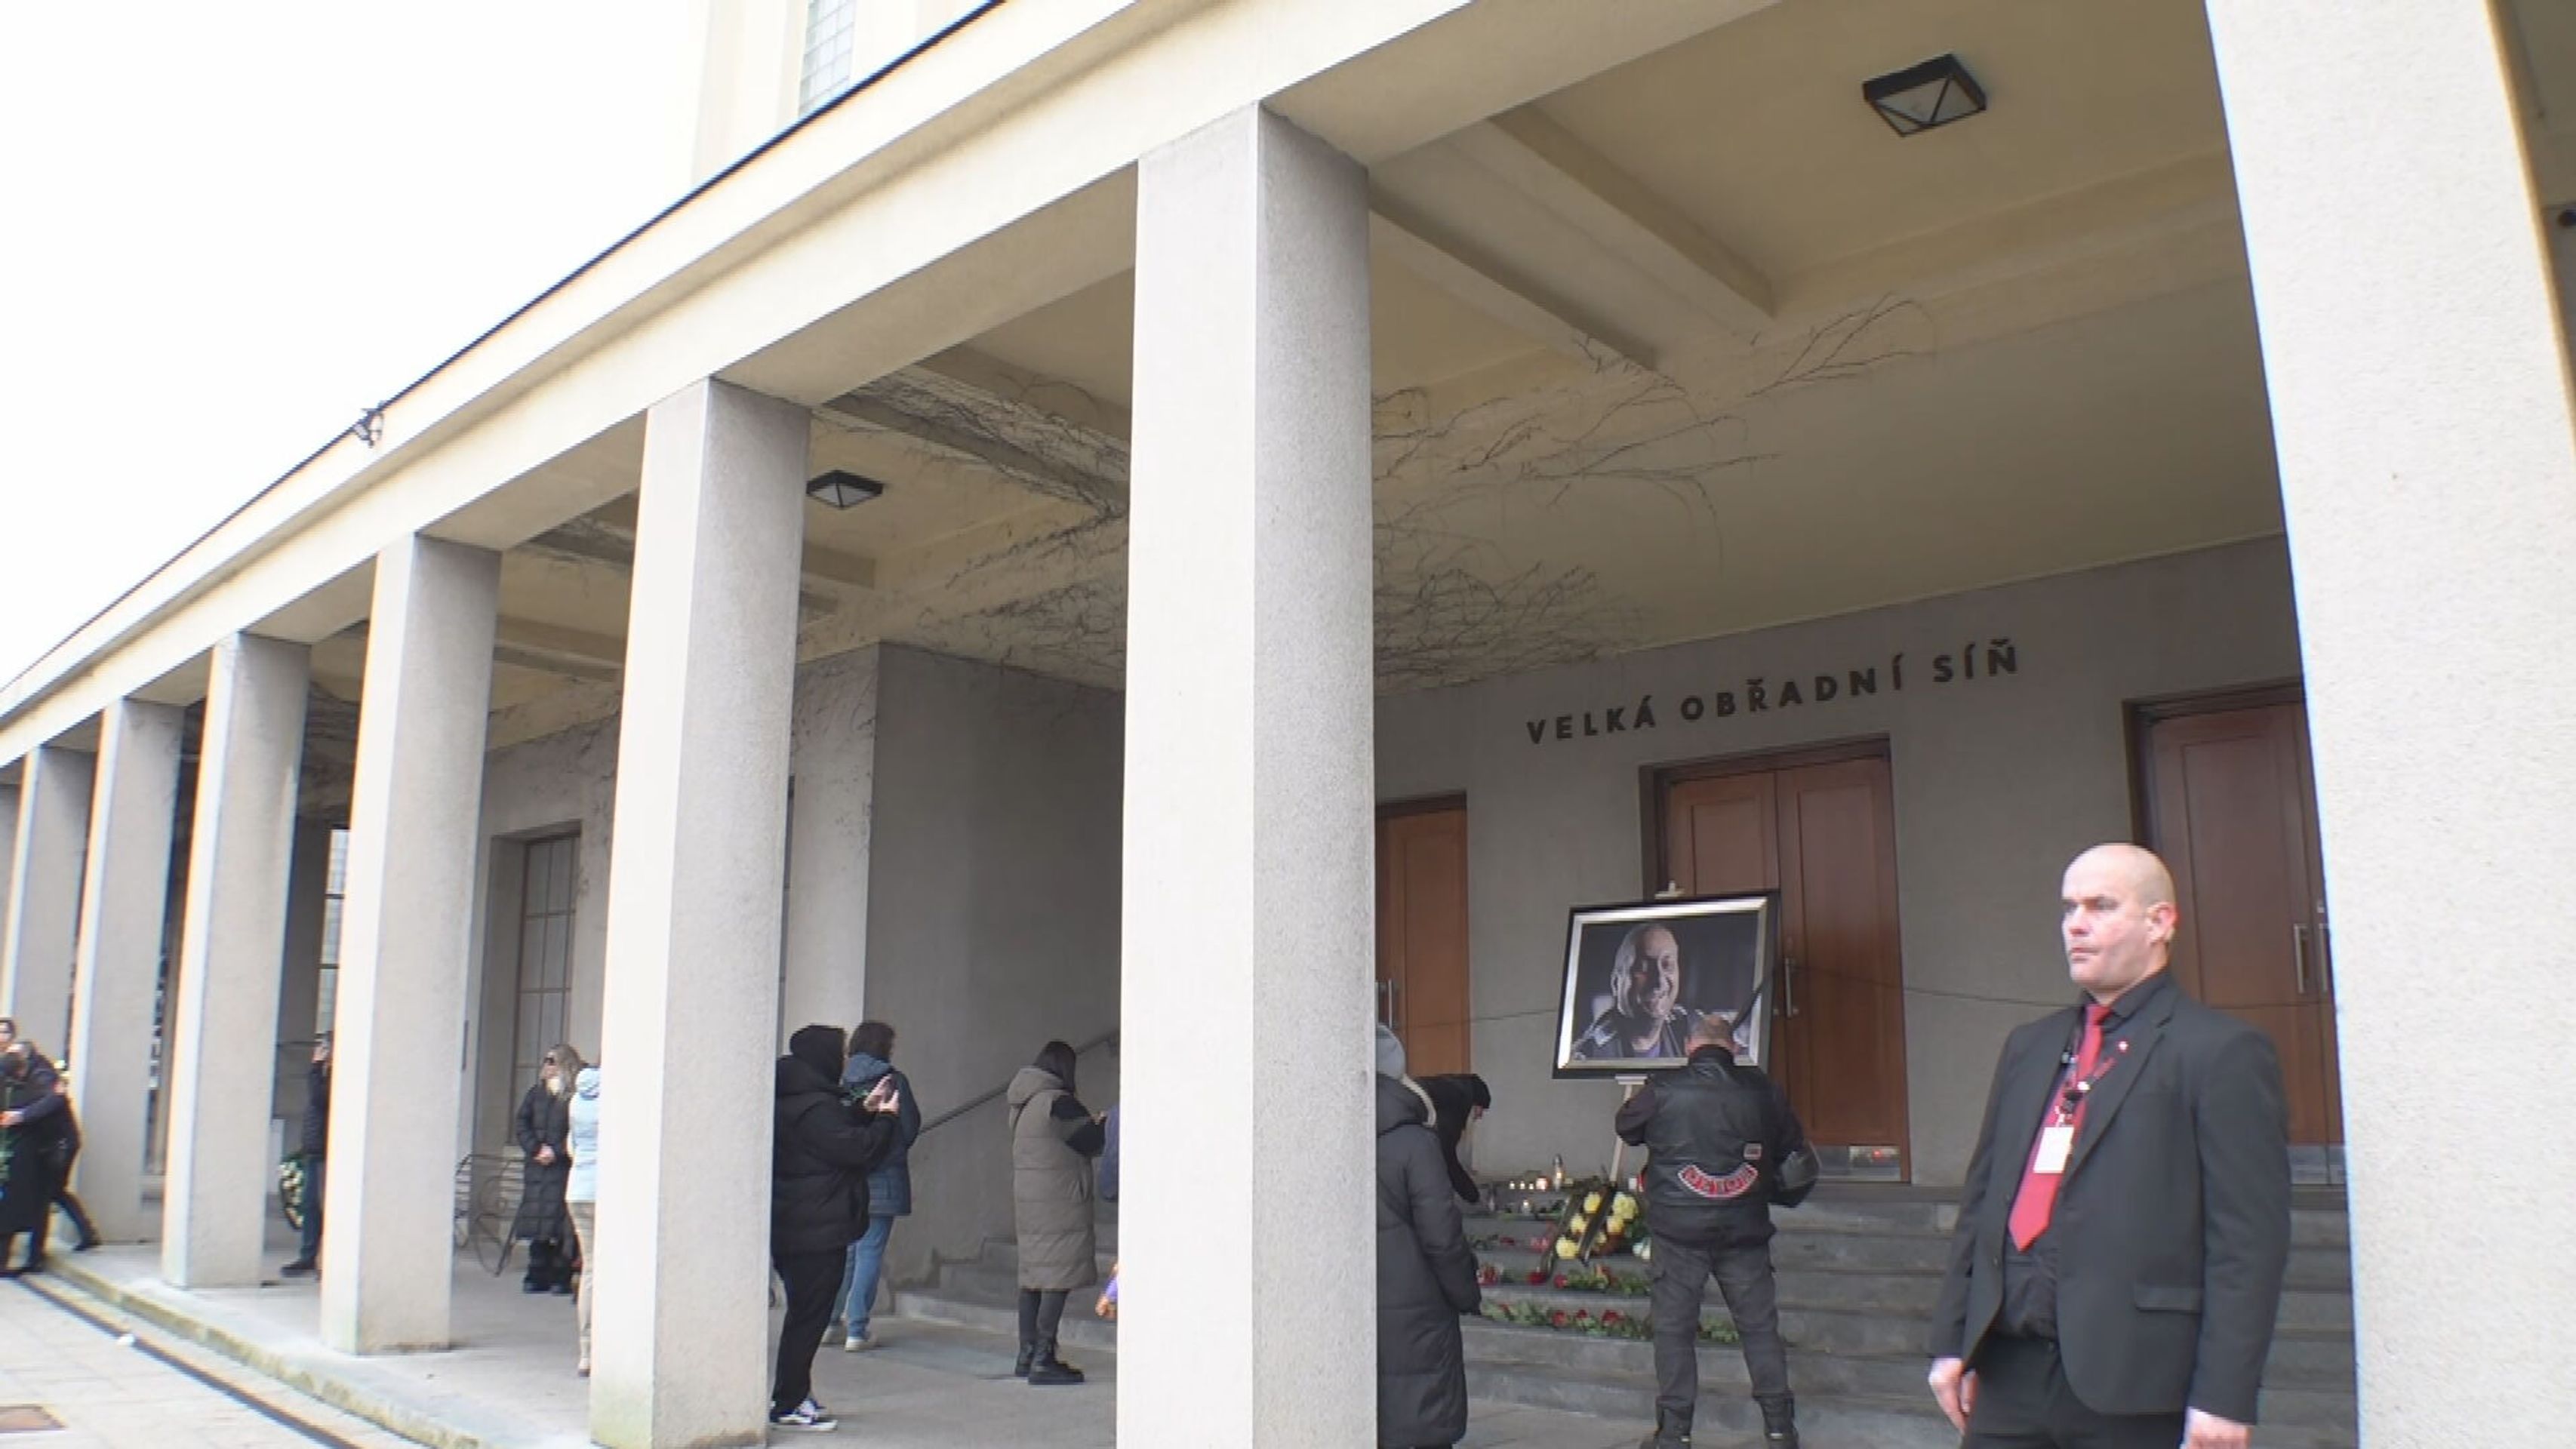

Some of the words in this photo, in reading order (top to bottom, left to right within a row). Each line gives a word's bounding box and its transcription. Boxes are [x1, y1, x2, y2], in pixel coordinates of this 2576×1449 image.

[1527, 695, 1657, 744] VELKÁ
[1680, 652, 1904, 721] OBŘADNÍ
[1932, 638, 2017, 682] SÍŇ
